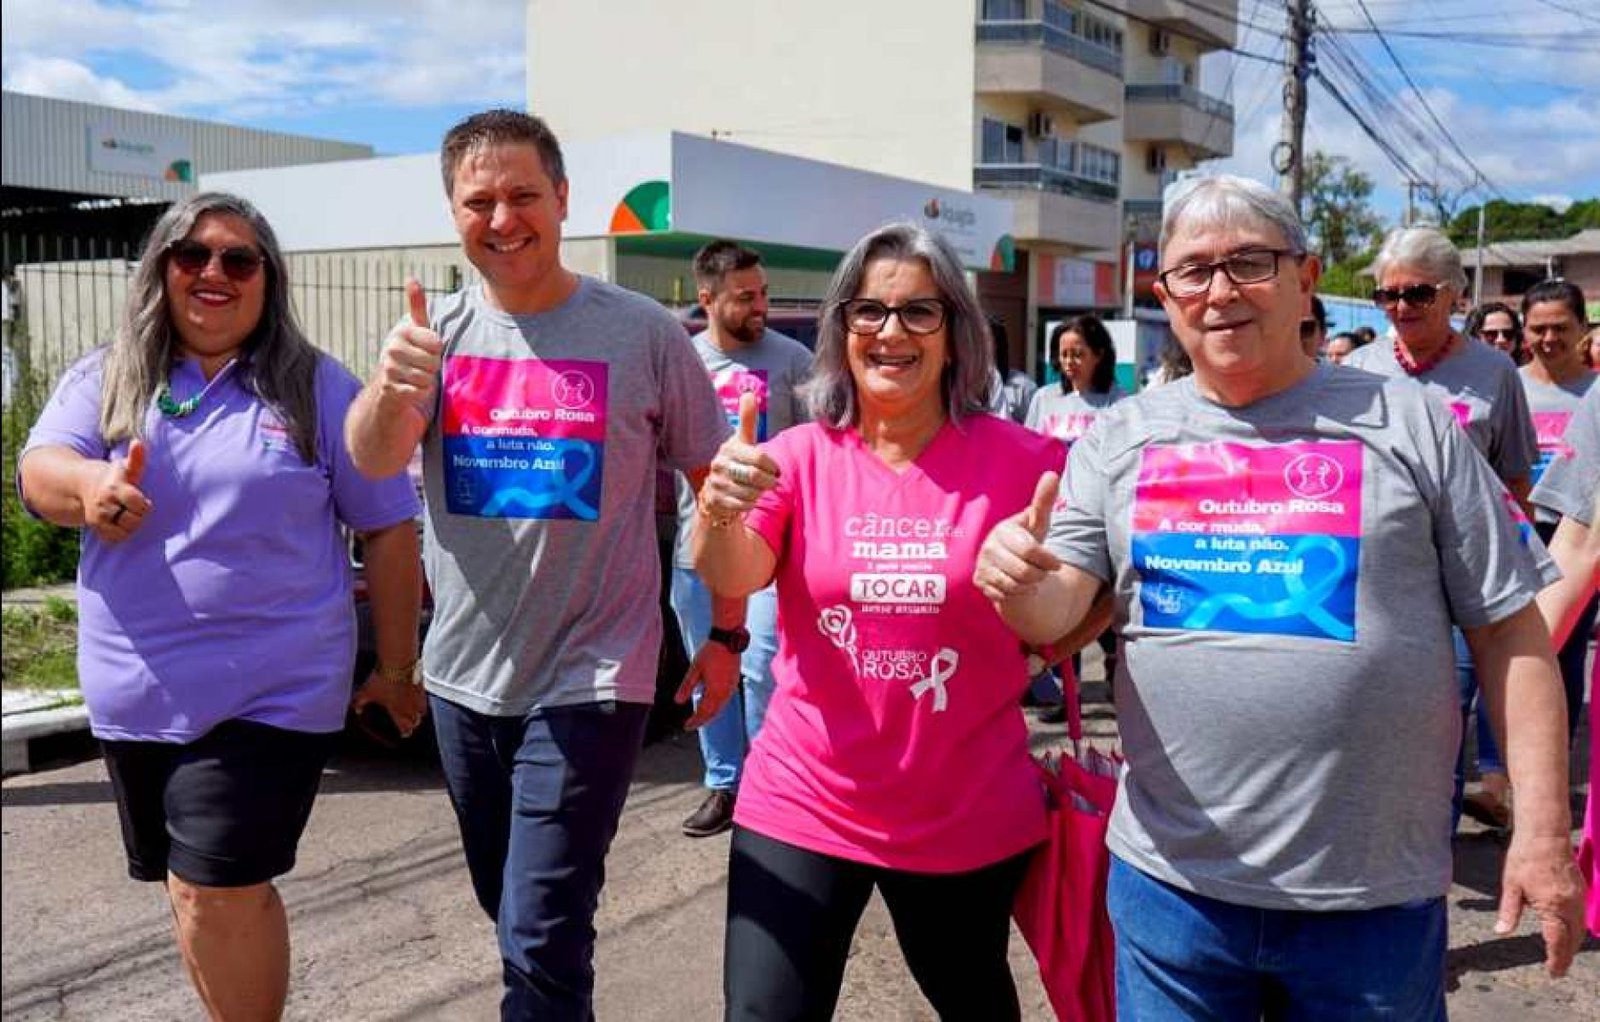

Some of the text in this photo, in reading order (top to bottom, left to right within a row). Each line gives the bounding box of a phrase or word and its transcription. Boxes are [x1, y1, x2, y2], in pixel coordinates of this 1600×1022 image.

[490, 408, 595, 422] Outubro Rosa
[461, 424, 470, 434] A
[486, 440, 495, 449] a
[453, 454, 565, 470] Novembro Azul
[1198, 499, 1344, 514] Outubro Rosa
[844, 512, 948, 538] câncer
[1158, 518, 1265, 534] A cor muda,
[852, 541, 948, 559] mama
[1194, 537, 1289, 551] a luta não.
[1145, 555, 1304, 574] Novembro Azul
[860, 579, 937, 598] TOCAR
[862, 650, 927, 662] OUTUBRO
[863, 661, 925, 680] ROSA
